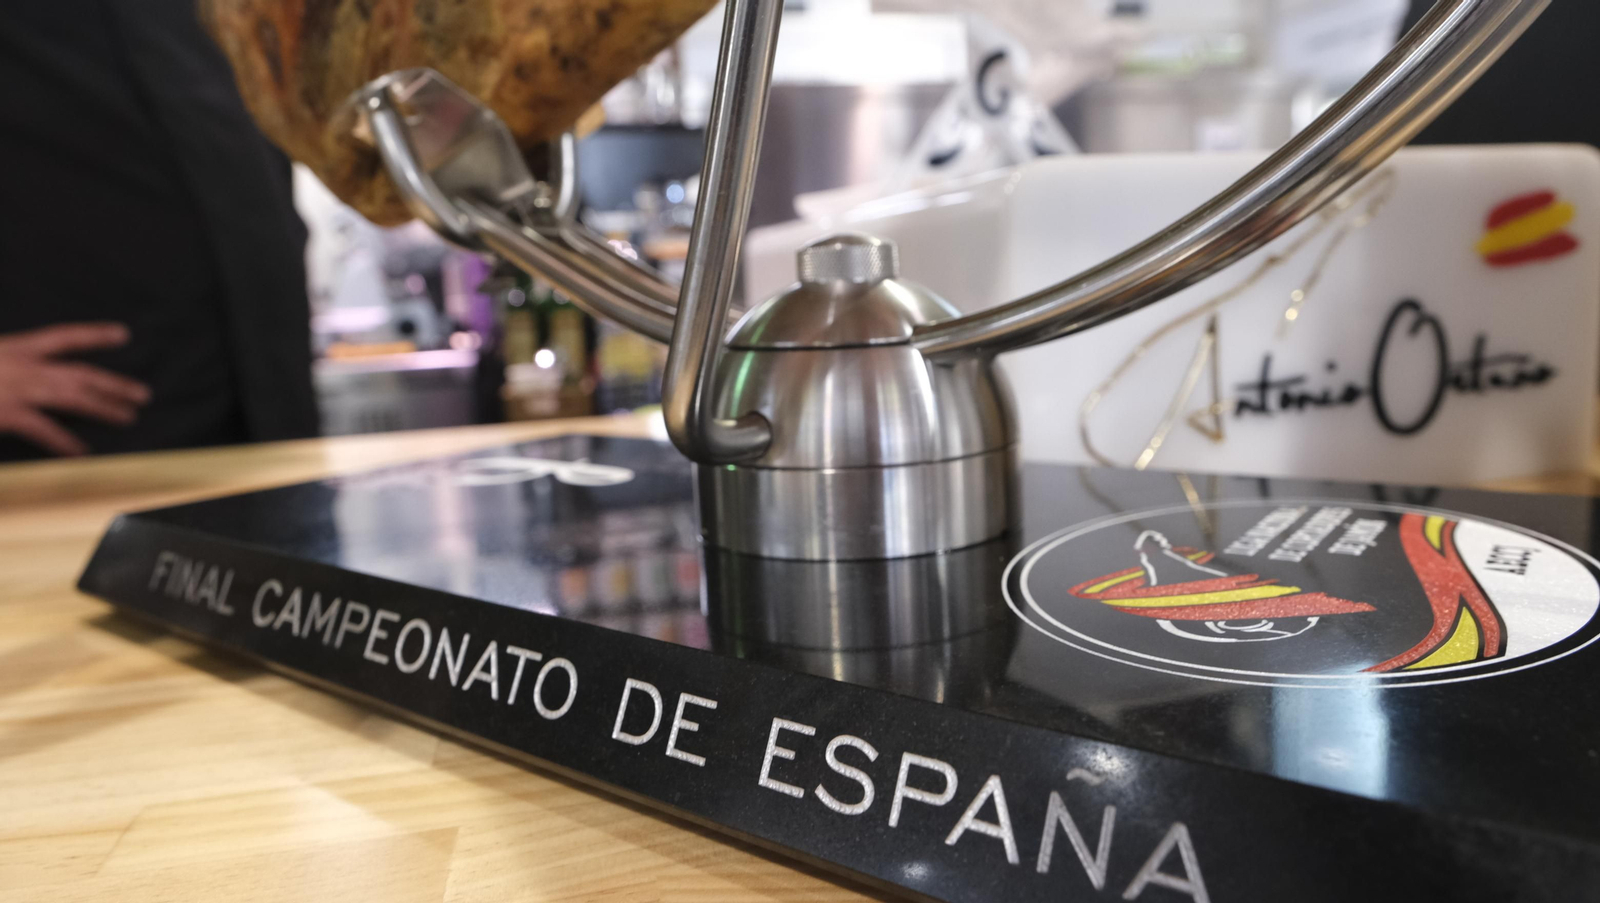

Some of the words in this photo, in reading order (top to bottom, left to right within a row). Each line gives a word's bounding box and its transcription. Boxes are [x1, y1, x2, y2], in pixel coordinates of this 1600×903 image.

[148, 550, 235, 617] FINAL
[251, 577, 578, 720] CAMPEONATO
[611, 677, 718, 767] DE
[757, 717, 1211, 903] ESPAÑA
